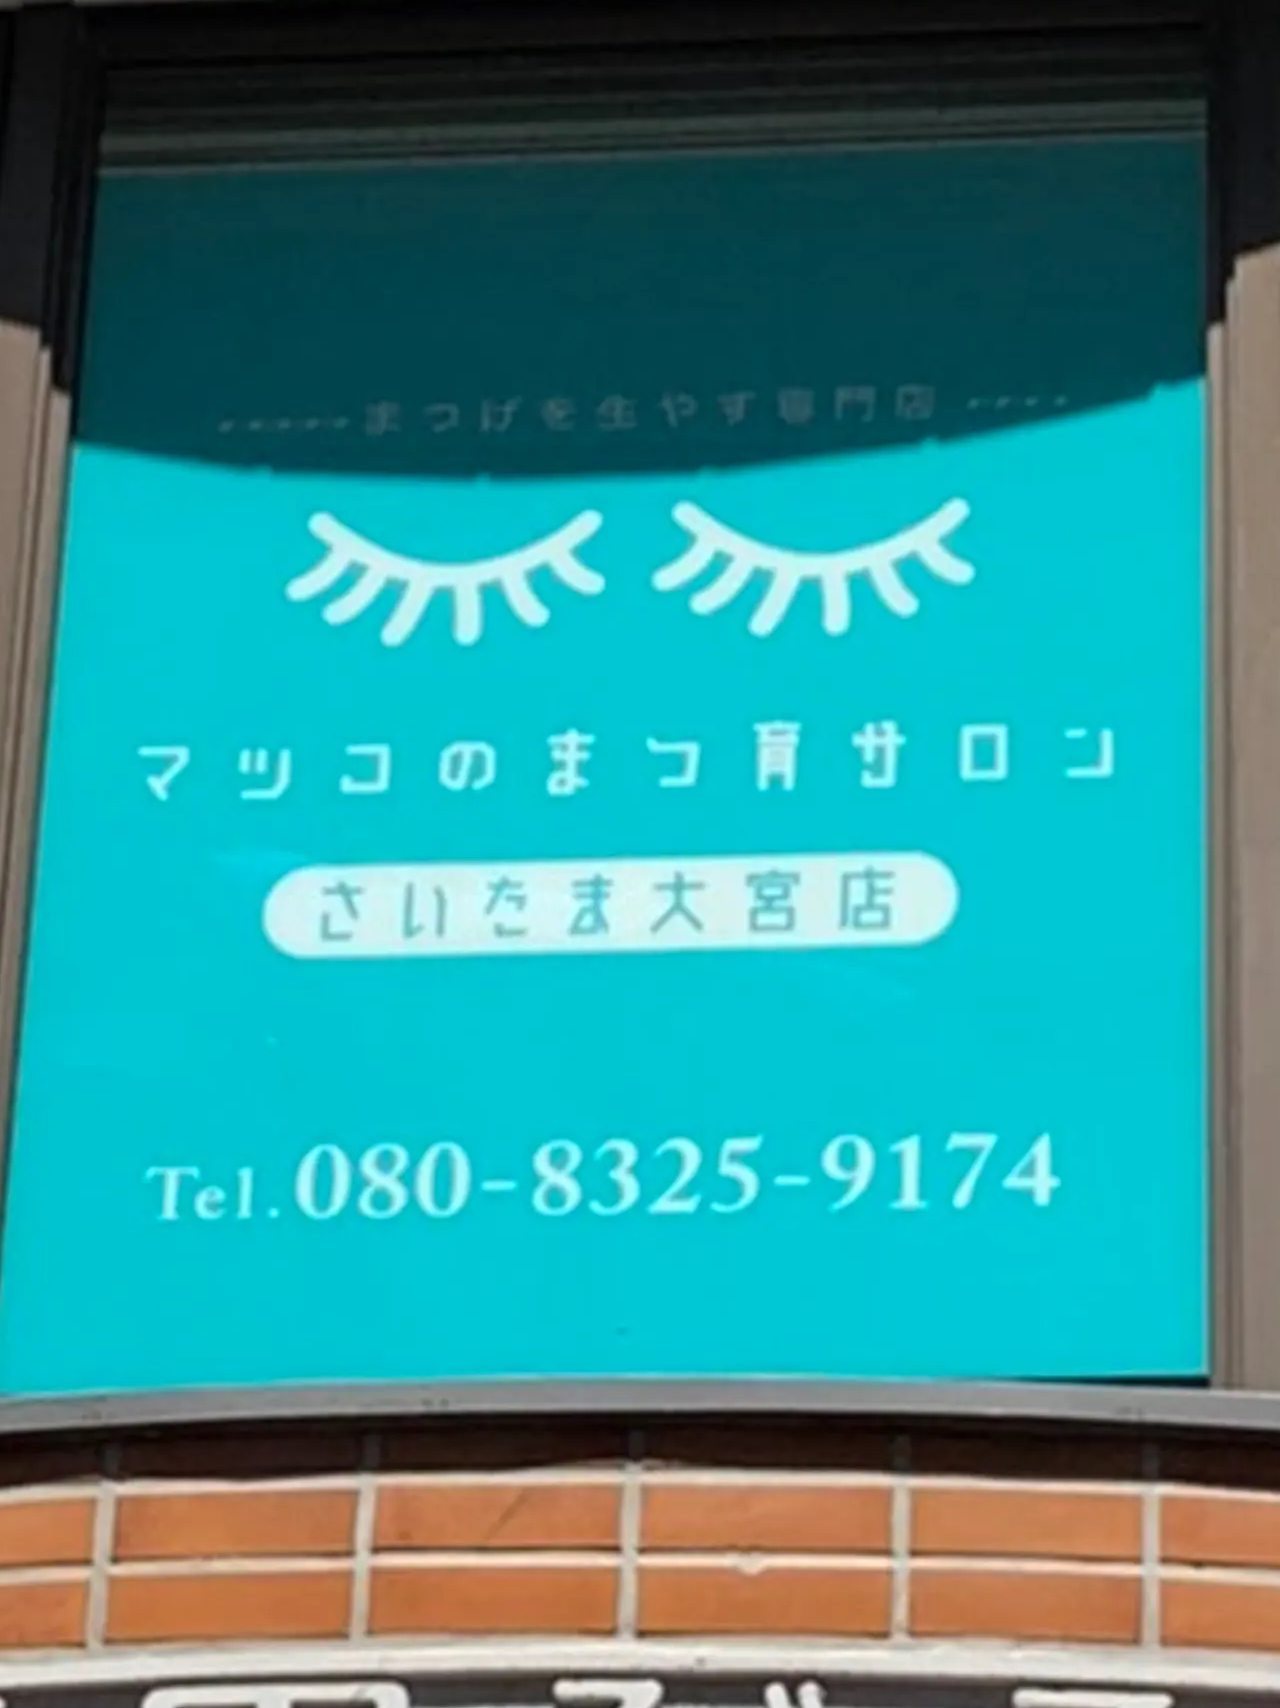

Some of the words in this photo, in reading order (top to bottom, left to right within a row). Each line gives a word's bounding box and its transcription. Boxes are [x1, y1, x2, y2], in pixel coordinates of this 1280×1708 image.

[136, 720, 1116, 801] マツコのまつ育サロン
[318, 866, 897, 943] さいたま大宮店
